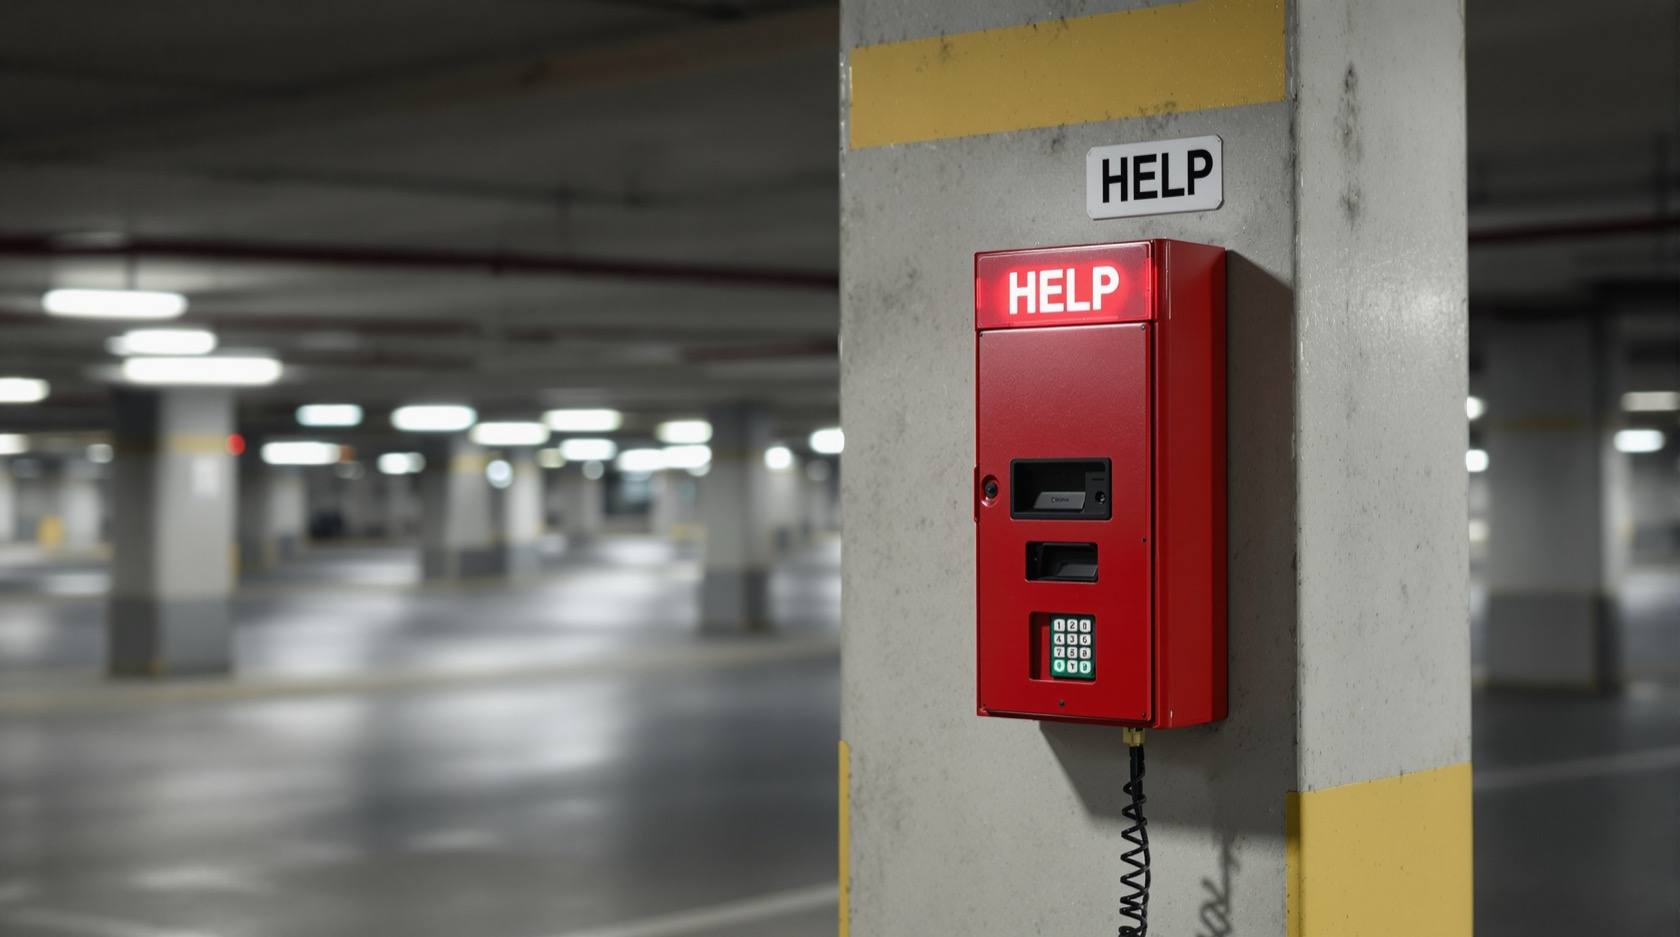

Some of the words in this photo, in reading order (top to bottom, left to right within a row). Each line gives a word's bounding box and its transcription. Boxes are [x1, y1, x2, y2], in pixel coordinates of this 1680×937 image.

[1102, 149, 1214, 203] HELP
[1009, 266, 1120, 314] HELP
[1069, 621, 1075, 630] 2
